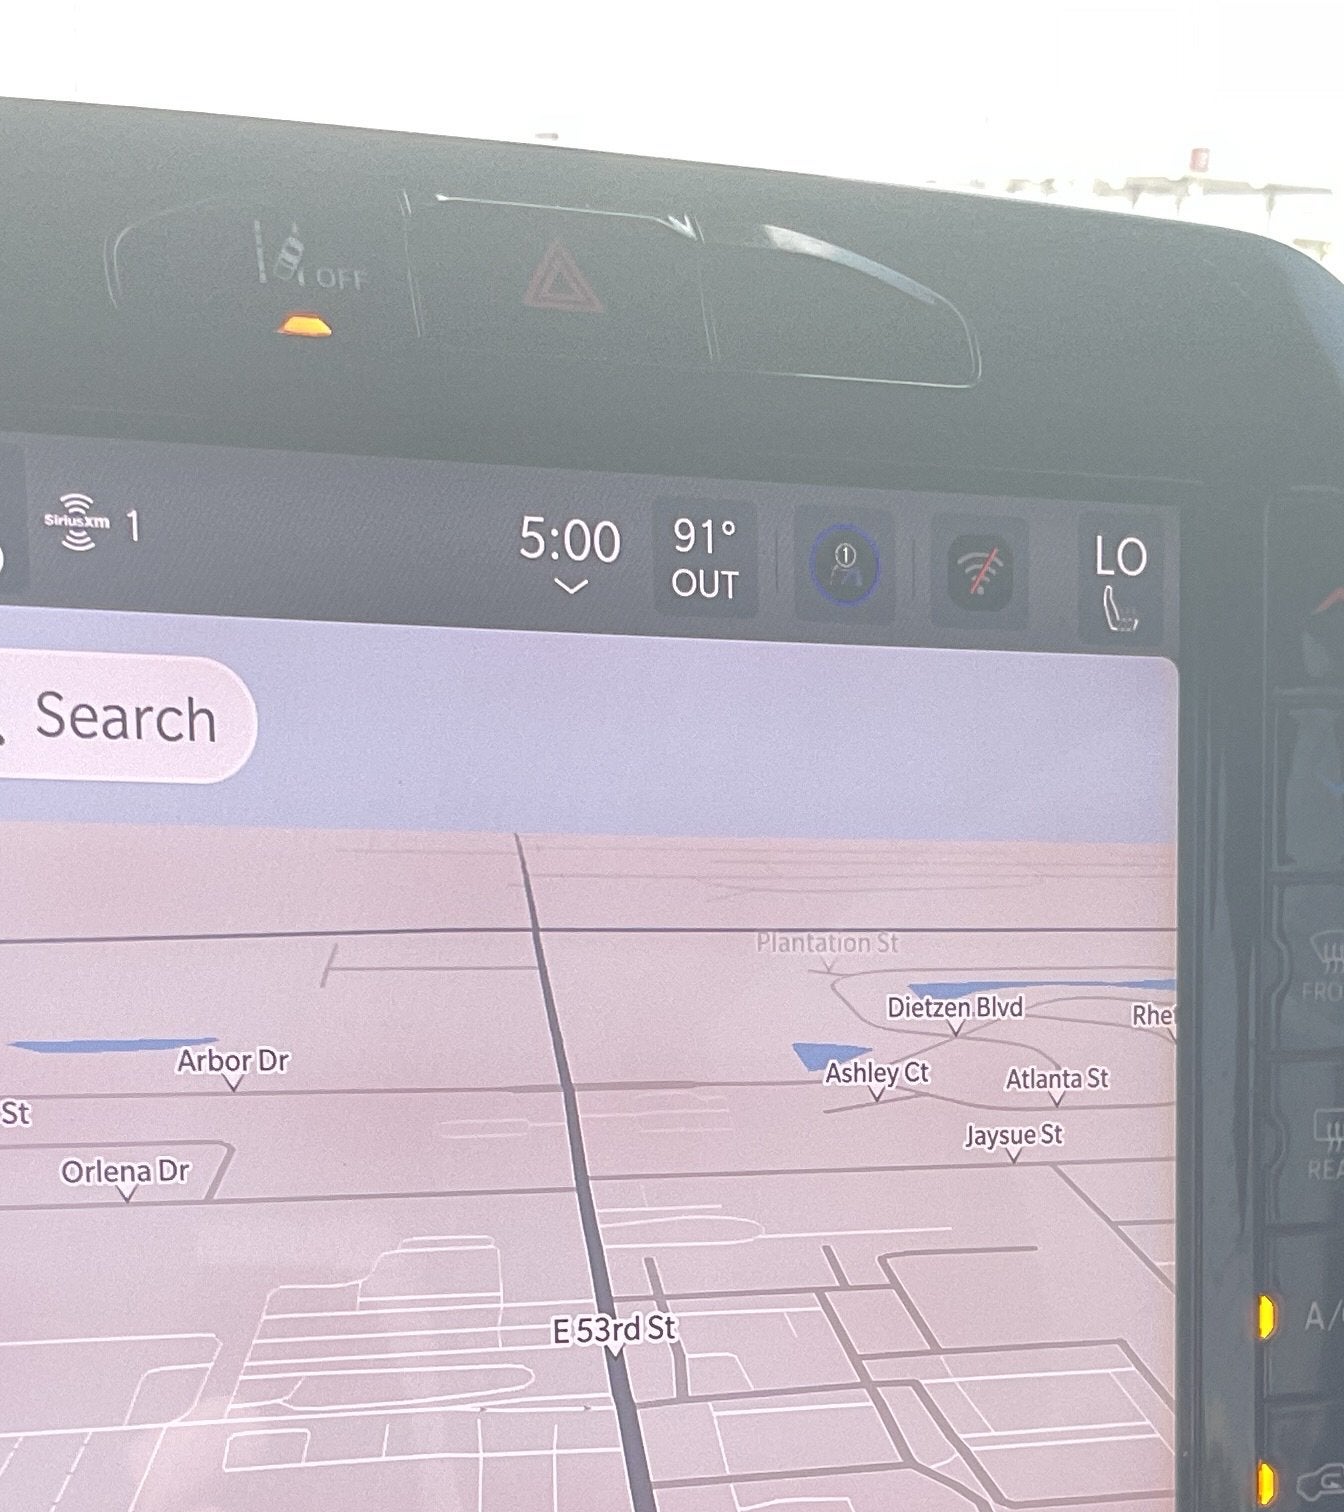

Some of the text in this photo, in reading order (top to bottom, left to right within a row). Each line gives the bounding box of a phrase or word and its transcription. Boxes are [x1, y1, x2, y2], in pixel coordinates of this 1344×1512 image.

[316, 267, 369, 291] OFF
[126, 509, 139, 543] 1
[672, 518, 737, 555] 91°
[519, 515, 622, 564] 5:00
[1095, 534, 1149, 577] LO
[671, 568, 740, 600] OUT
[36, 690, 217, 743] Search
[757, 931, 899, 953] Plantation St
[888, 996, 1024, 1019] Dietzen Blvd
[1133, 1003, 1173, 1026] Rhe
[177, 1049, 290, 1074] Arbor Dr
[825, 1061, 930, 1087] Ashley Ct
[1006, 1068, 1110, 1091] Atlanta St
[1, 1100, 31, 1125] St
[965, 1124, 1064, 1149] Jaysue St
[61, 1159, 191, 1184] Orlena Dr
[554, 1315, 676, 1344] E 53rd St
